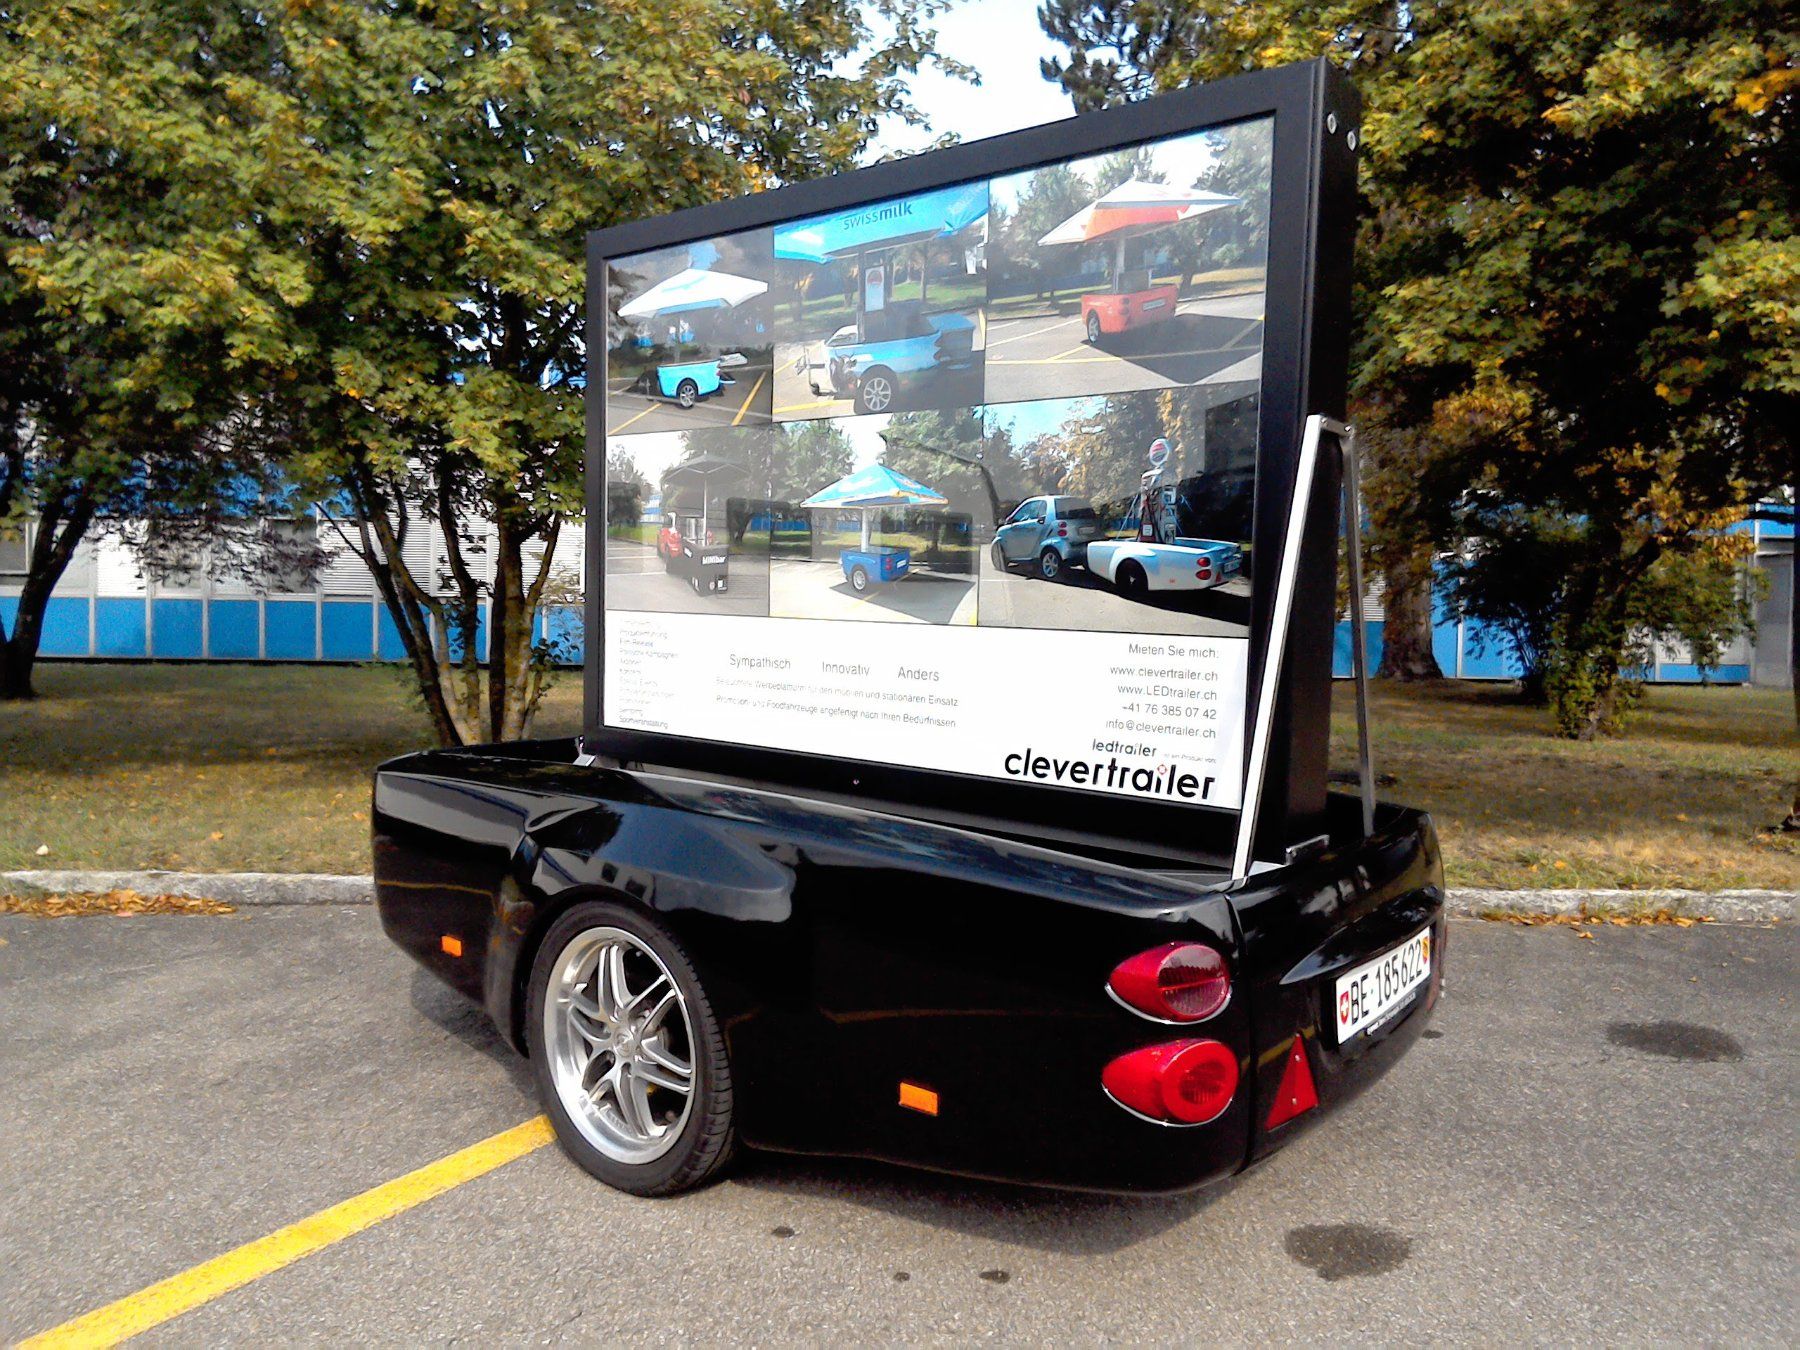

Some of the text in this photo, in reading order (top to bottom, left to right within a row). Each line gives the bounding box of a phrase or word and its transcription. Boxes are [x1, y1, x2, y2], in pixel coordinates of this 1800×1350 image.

[1128, 643, 1165, 656] Mieten
[1168, 645, 1185, 657] Sie
[729, 653, 940, 682] Sympathisch Innovativ Anders
[1110, 666, 1218, 682] www.clevertrailer.ch
[928, 694, 959, 707] Einsatz
[1117, 685, 1218, 701] www.LEDtrailer.ch
[1145, 704, 1158, 715] 76
[1161, 705, 1182, 717] 385
[1185, 707, 1199, 718] 07
[1202, 709, 1217, 720] 42
[1105, 719, 1216, 739] info@clevertrailer.ch
[1092, 739, 1157, 758] ledtrailer
[1004, 748, 1216, 801] clevertrailer
